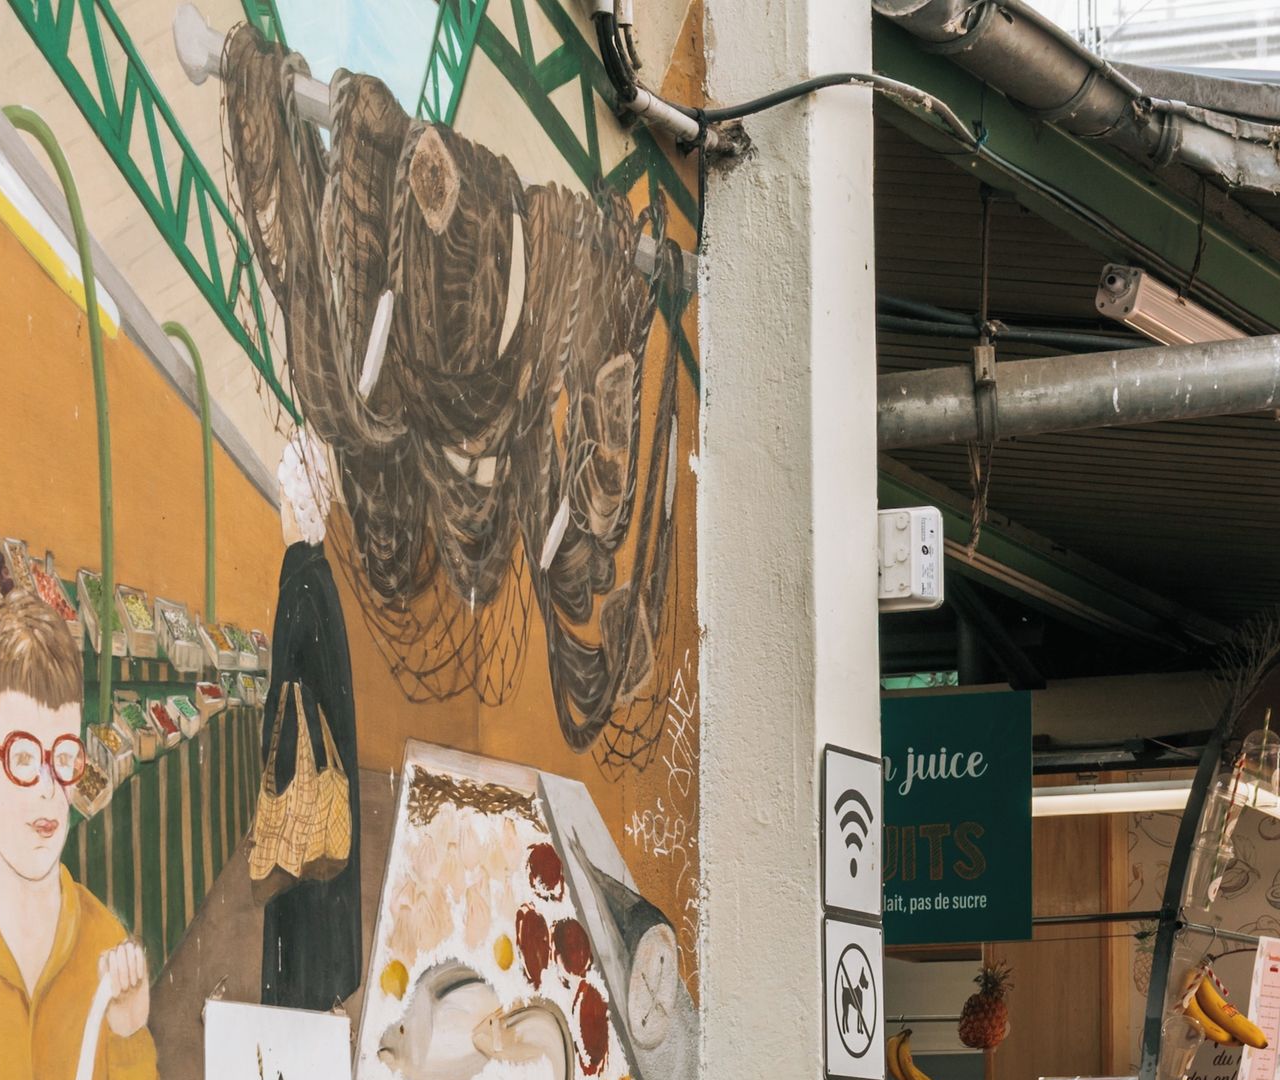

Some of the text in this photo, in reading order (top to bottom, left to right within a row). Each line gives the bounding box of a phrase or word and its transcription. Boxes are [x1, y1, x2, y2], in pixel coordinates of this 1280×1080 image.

[898, 747, 988, 796] juice
[883, 893, 987, 915] lait, pas de sucre
[1213, 1050, 1235, 1067] du
